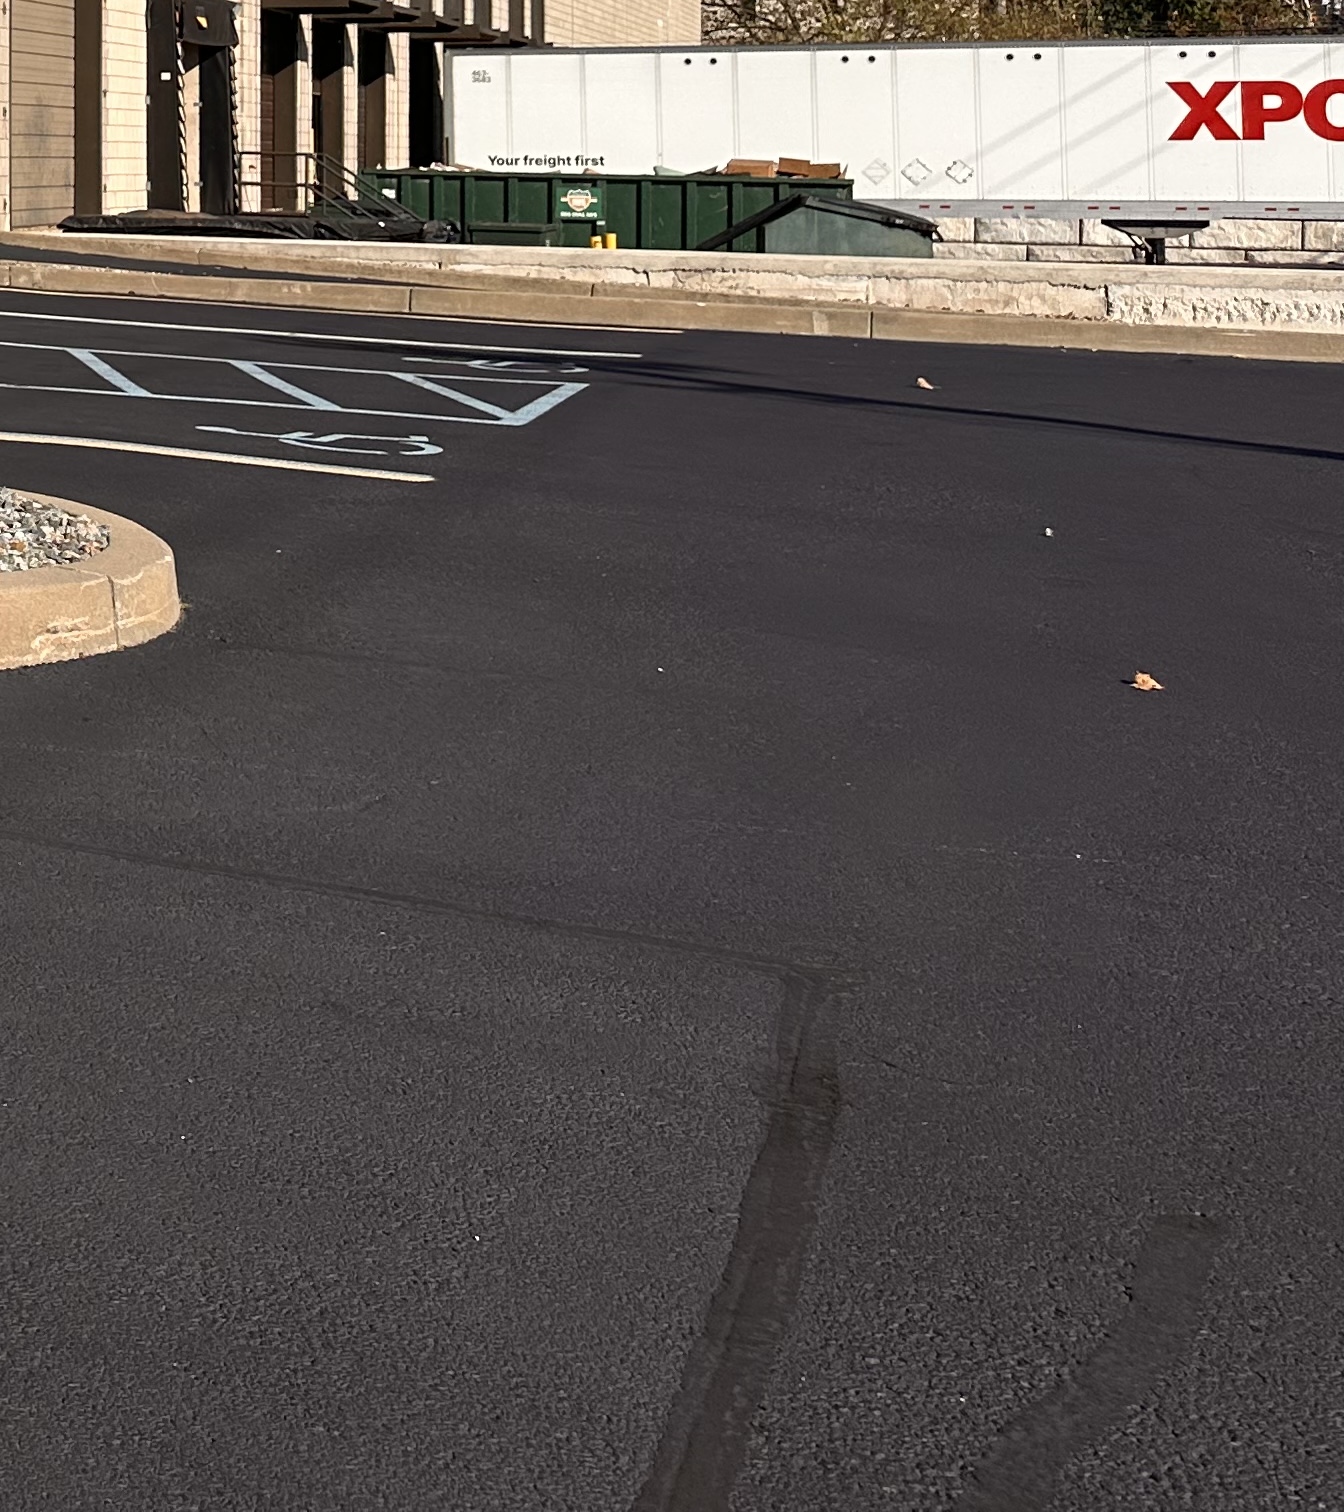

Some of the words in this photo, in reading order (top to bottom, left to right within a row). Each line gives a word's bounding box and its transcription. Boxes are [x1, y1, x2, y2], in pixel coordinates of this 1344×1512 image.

[488, 155, 520, 166] Your
[523, 155, 571, 168] freight
[574, 155, 605, 166] first
